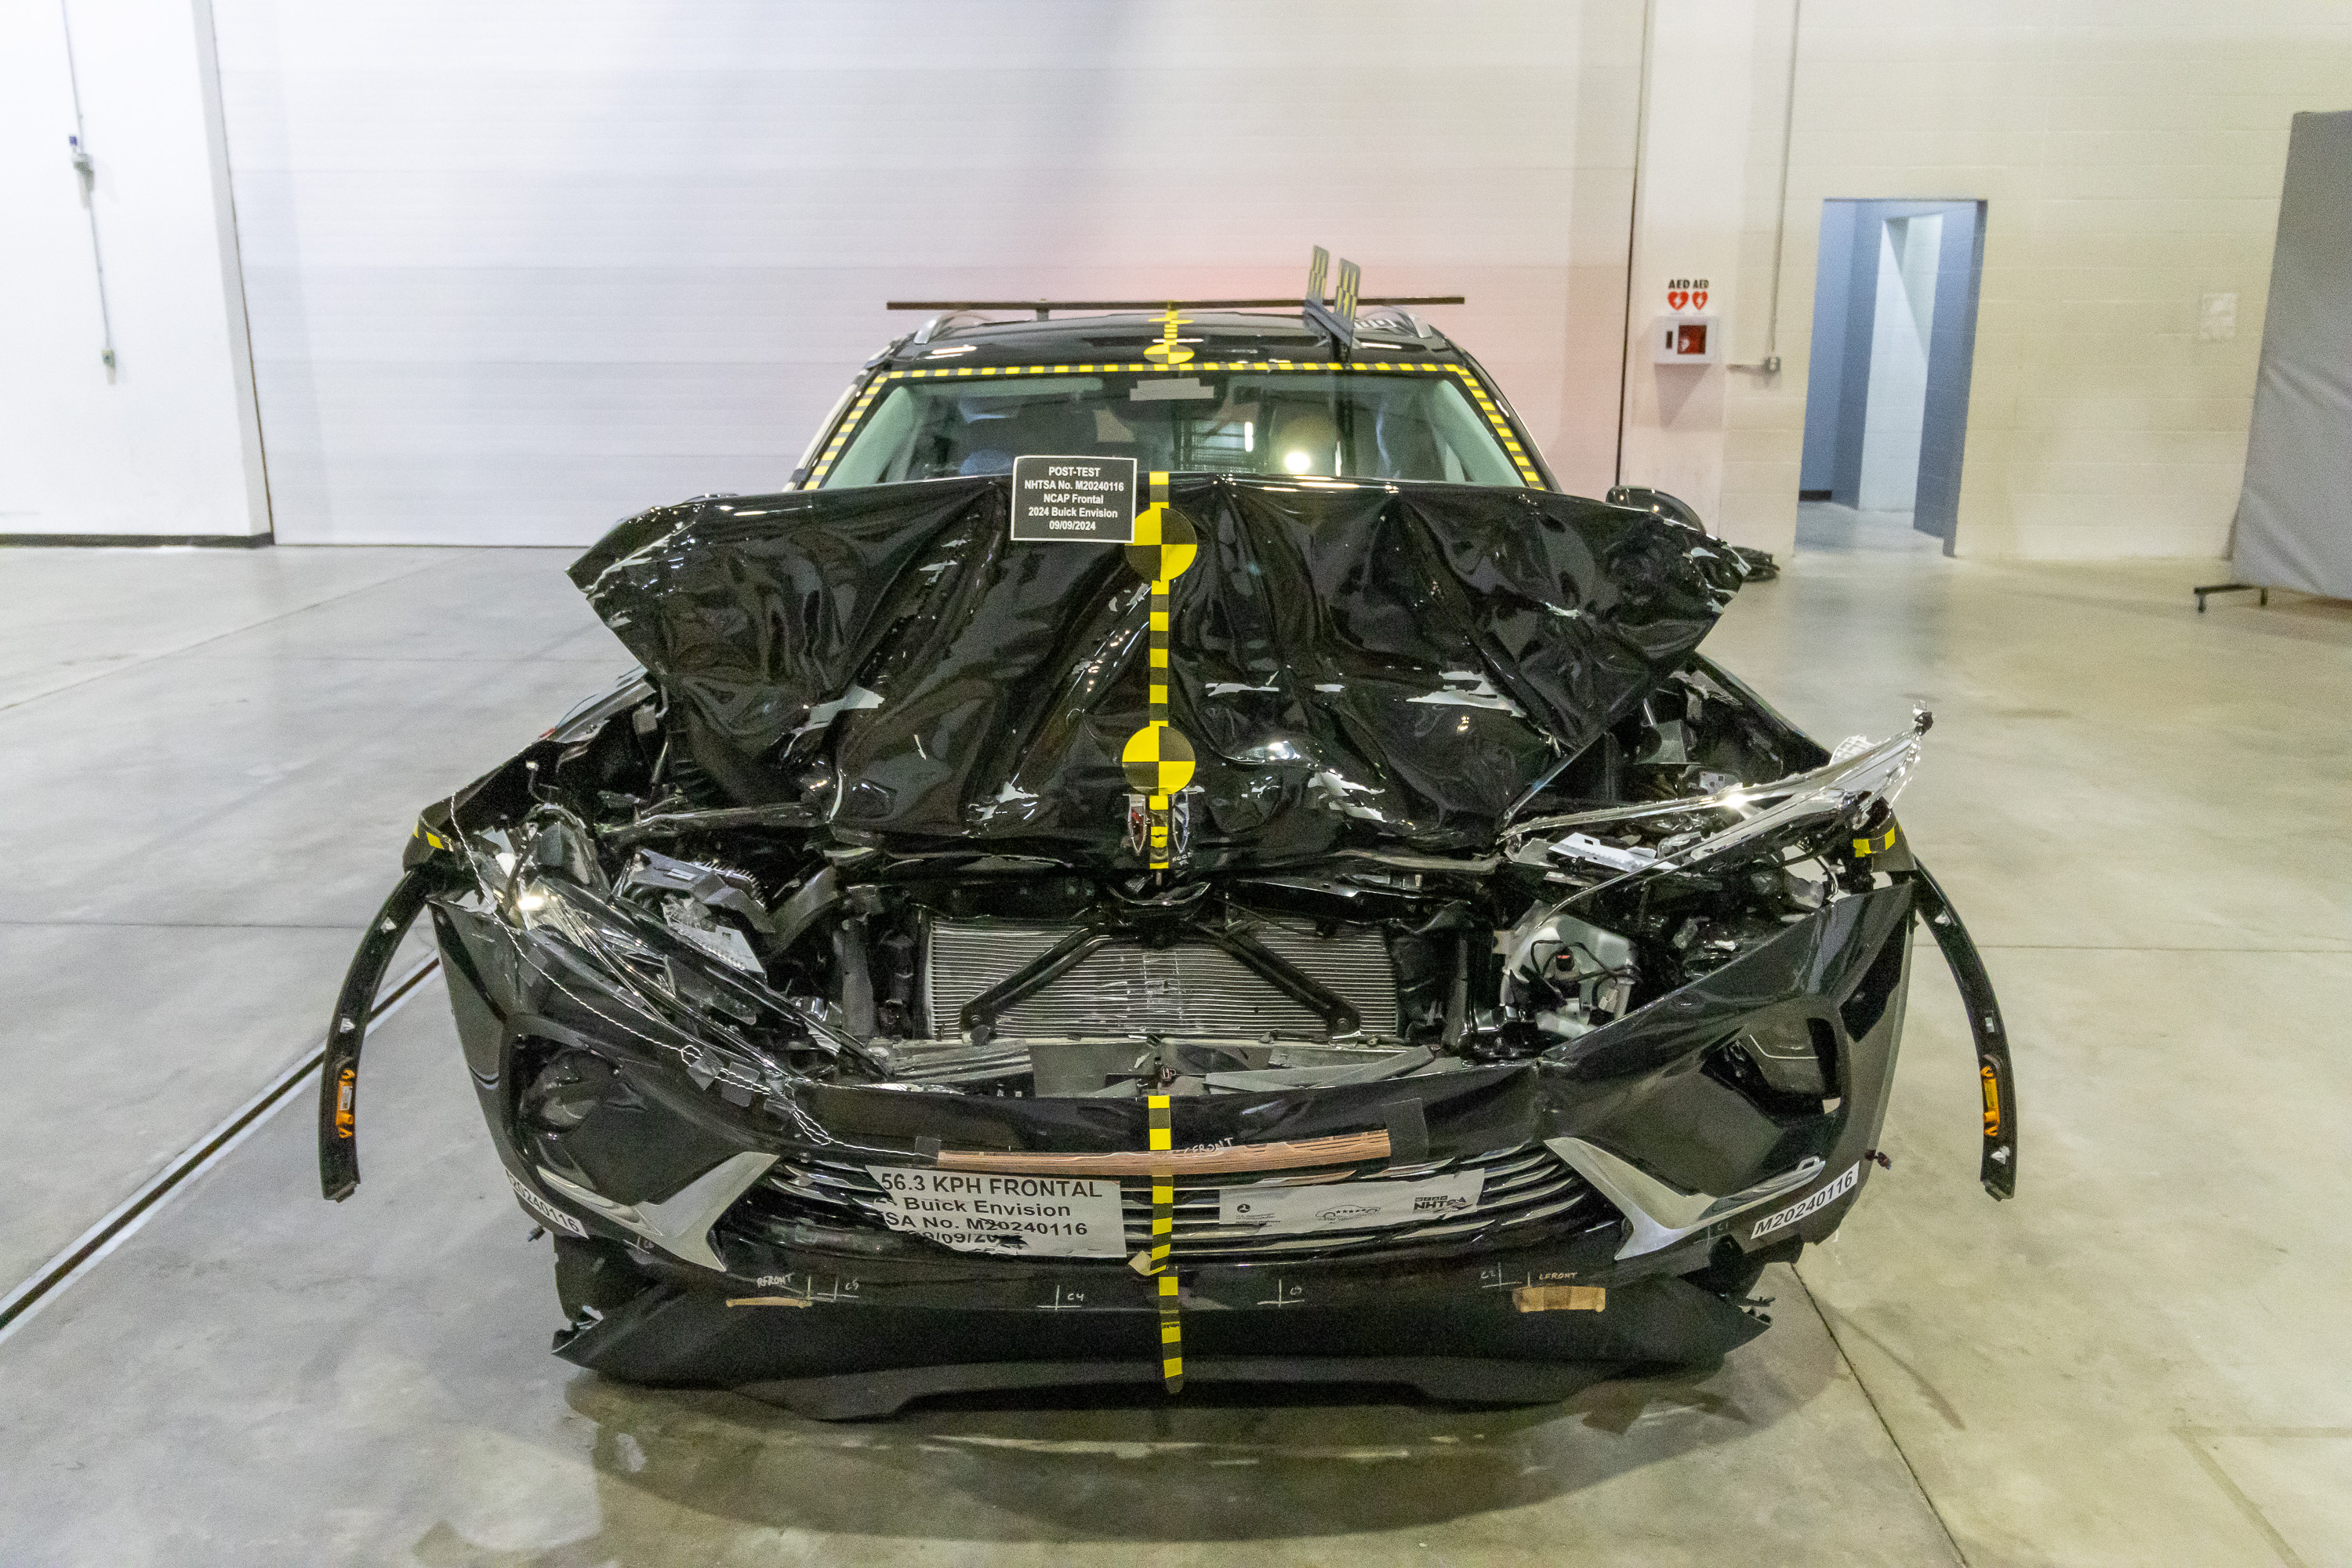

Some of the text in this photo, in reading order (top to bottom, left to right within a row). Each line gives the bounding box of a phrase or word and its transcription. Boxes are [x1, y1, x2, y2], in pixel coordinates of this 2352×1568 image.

[1668, 279, 1690, 289] AED
[1048, 466, 1101, 477] POST-TEST
[1024, 480, 1124, 492] NHTSA No. M20240116
[1044, 494, 1104, 504] NCAP Frontal
[1028, 506, 1118, 518] 2024 Buick Envision
[1049, 521, 1096, 531] 09/09/2024
[881, 1173, 1102, 1197] 56.3 KPH FRONTAL
[903, 1197, 967, 1212] Buick
[974, 1200, 1070, 1217] Envision
[1755, 1171, 1853, 1235] M20240116
[884, 1211, 1087, 1236] SA No. M20240116
[1067, 1293, 1084, 1301] C4
